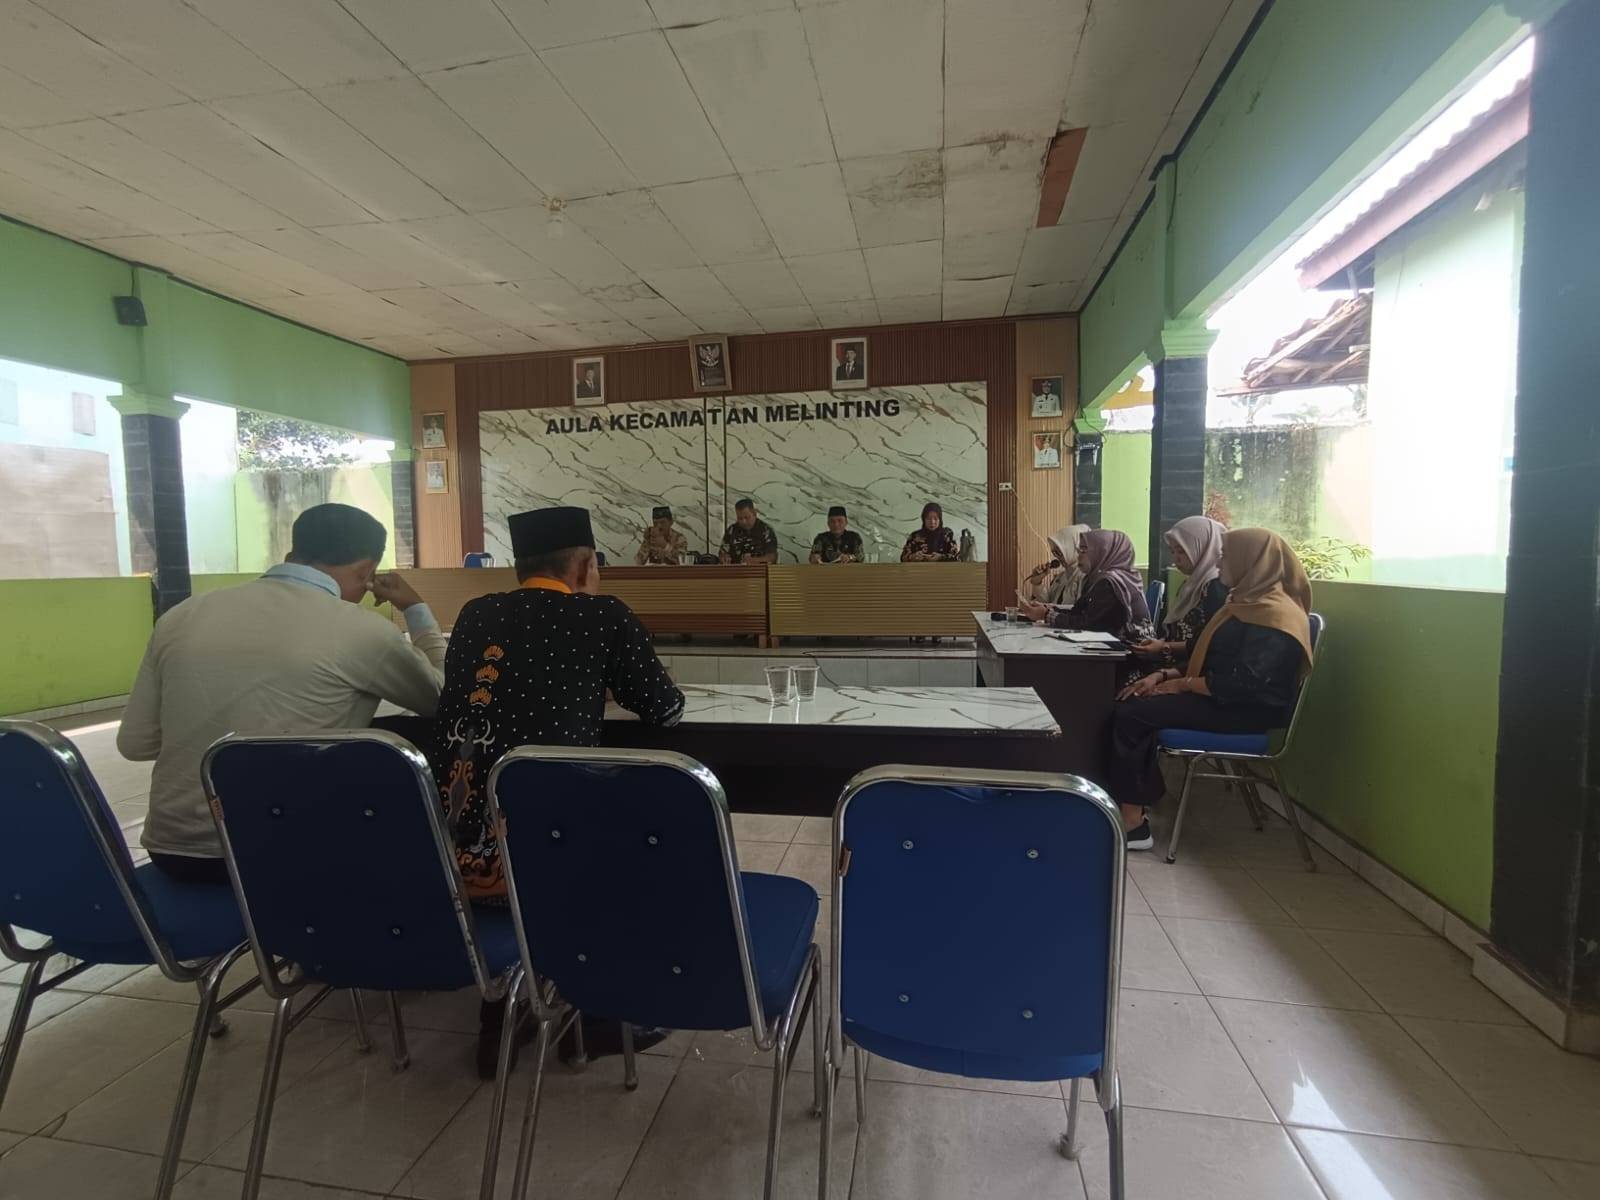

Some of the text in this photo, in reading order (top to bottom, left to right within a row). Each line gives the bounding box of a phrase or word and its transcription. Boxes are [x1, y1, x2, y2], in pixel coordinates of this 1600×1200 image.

[546, 399, 900, 434] AULA KECAMATAN MELINTING
